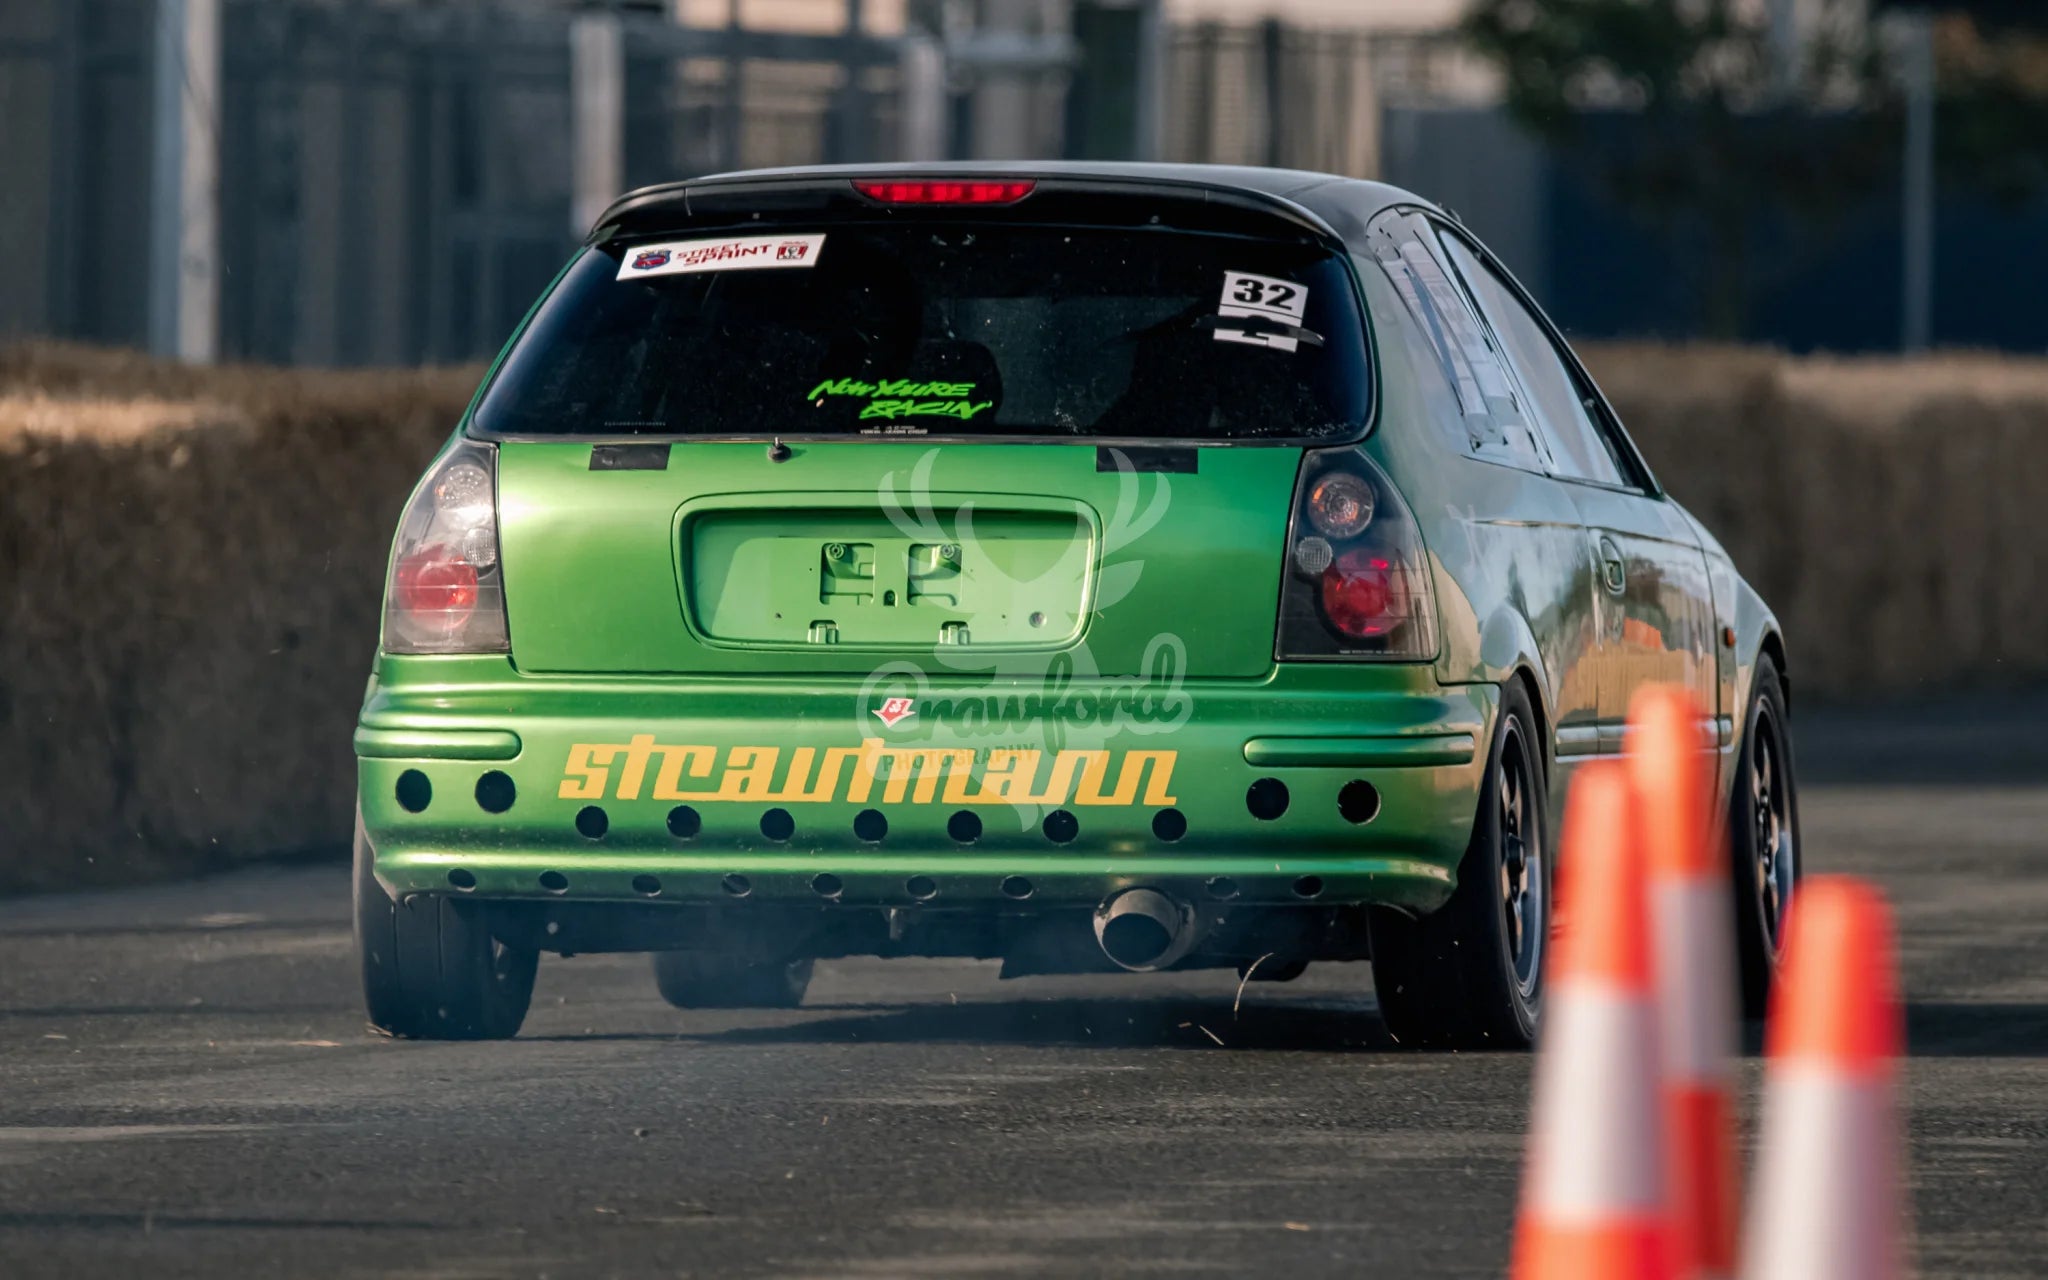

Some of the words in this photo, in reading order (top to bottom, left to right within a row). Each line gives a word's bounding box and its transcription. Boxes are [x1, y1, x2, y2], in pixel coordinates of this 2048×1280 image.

[676, 242, 742, 259] STREET
[683, 244, 772, 267] SPRINT
[1233, 278, 1297, 311] 32
